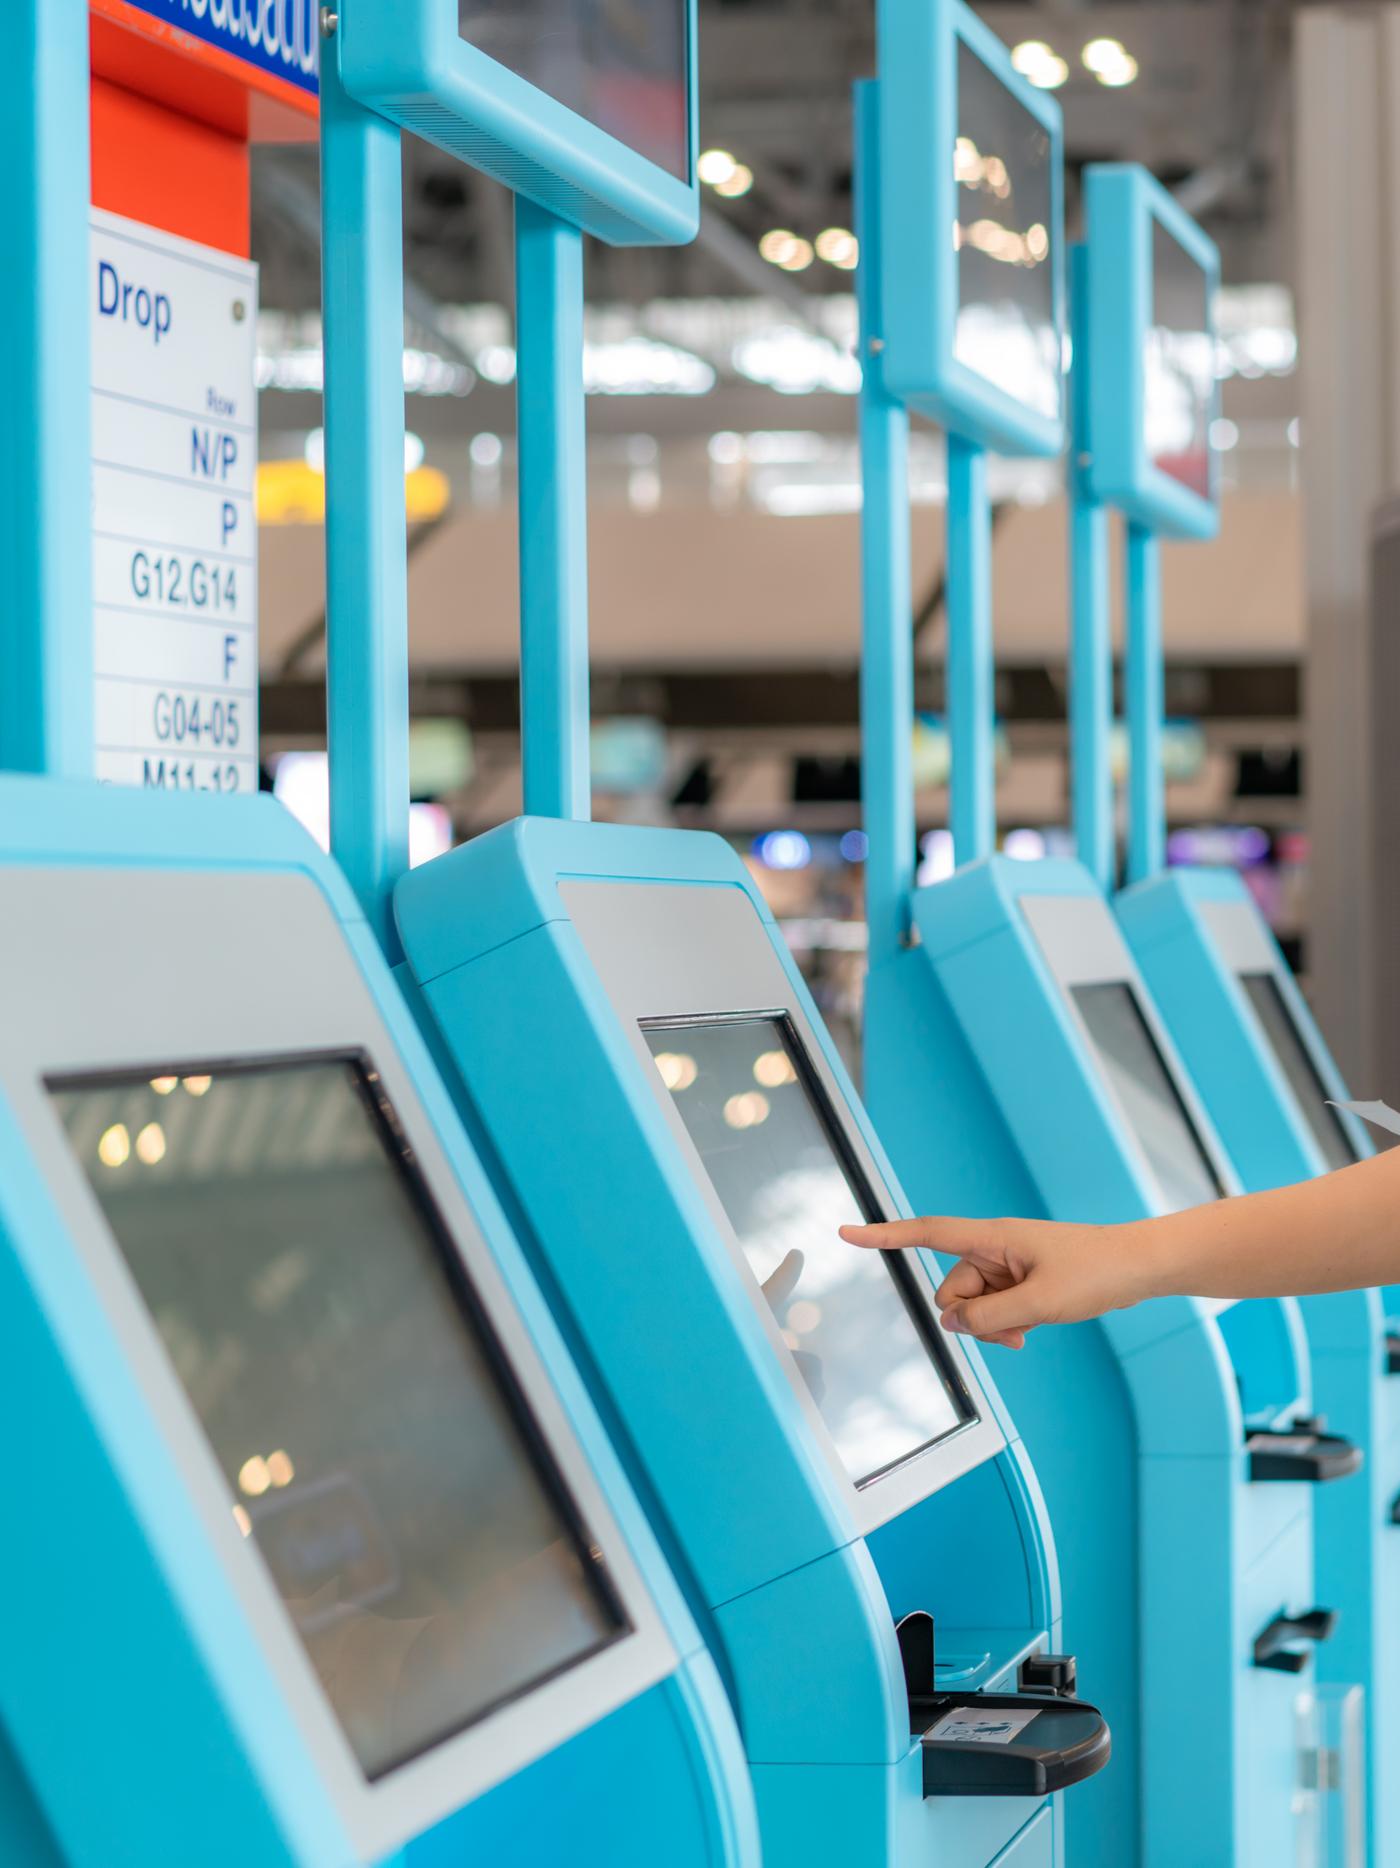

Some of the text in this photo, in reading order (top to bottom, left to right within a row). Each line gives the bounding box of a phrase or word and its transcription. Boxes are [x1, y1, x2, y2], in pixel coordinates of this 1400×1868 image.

[98, 261, 172, 345] Drop
[191, 427, 238, 480] N/P
[222, 501, 238, 546] P
[223, 635, 237, 681] F
[154, 692, 239, 748] G04-05
